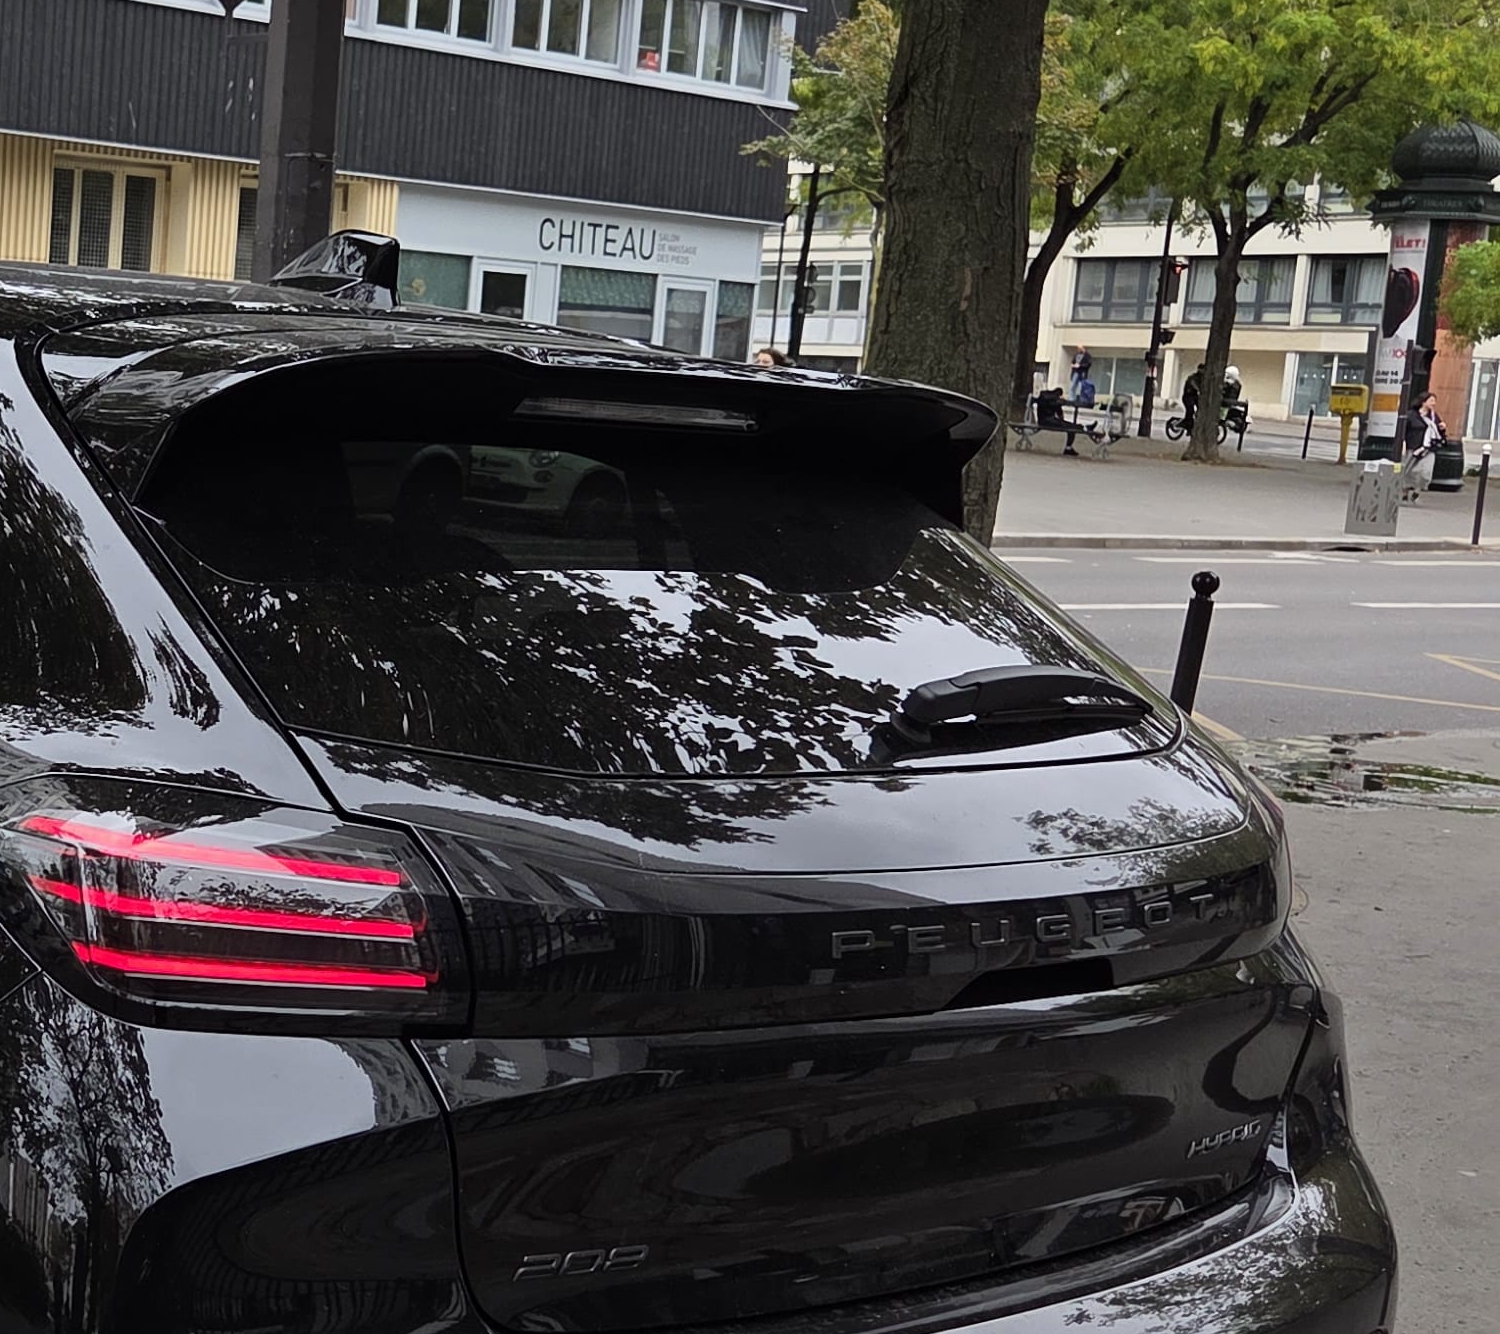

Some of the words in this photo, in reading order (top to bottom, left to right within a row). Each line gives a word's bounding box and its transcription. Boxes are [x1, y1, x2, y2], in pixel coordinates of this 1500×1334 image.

[539, 217, 656, 261] CHITEAU
[832, 893, 1214, 959] PEUGEOT
[512, 1243, 650, 1283] 208
